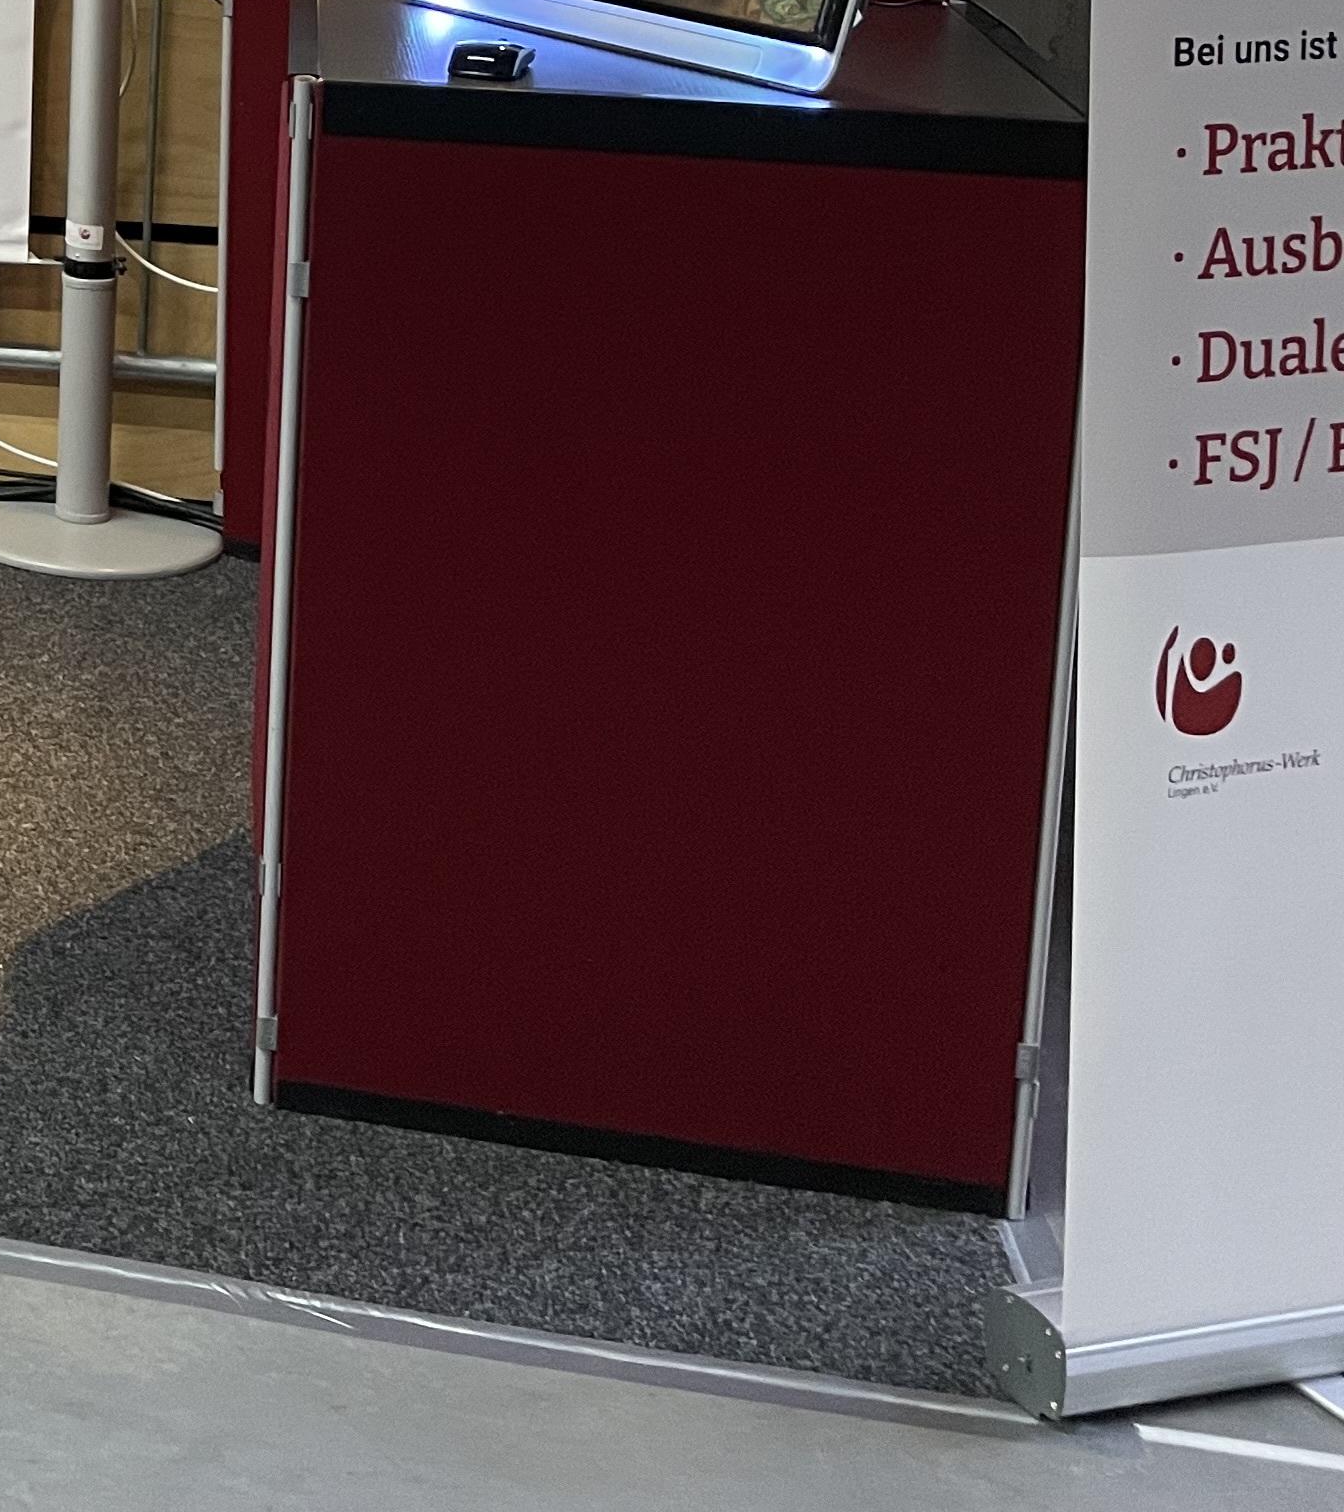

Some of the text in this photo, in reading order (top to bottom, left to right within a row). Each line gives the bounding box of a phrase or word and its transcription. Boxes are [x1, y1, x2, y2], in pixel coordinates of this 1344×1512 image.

[1174, 29, 1338, 66] Bei uns ist
[1197, 215, 1343, 280] Ausb
[1193, 427, 1283, 491] FSJ
[1293, 417, 1317, 482] /
[1167, 749, 1321, 784] Christophorus-Werk
